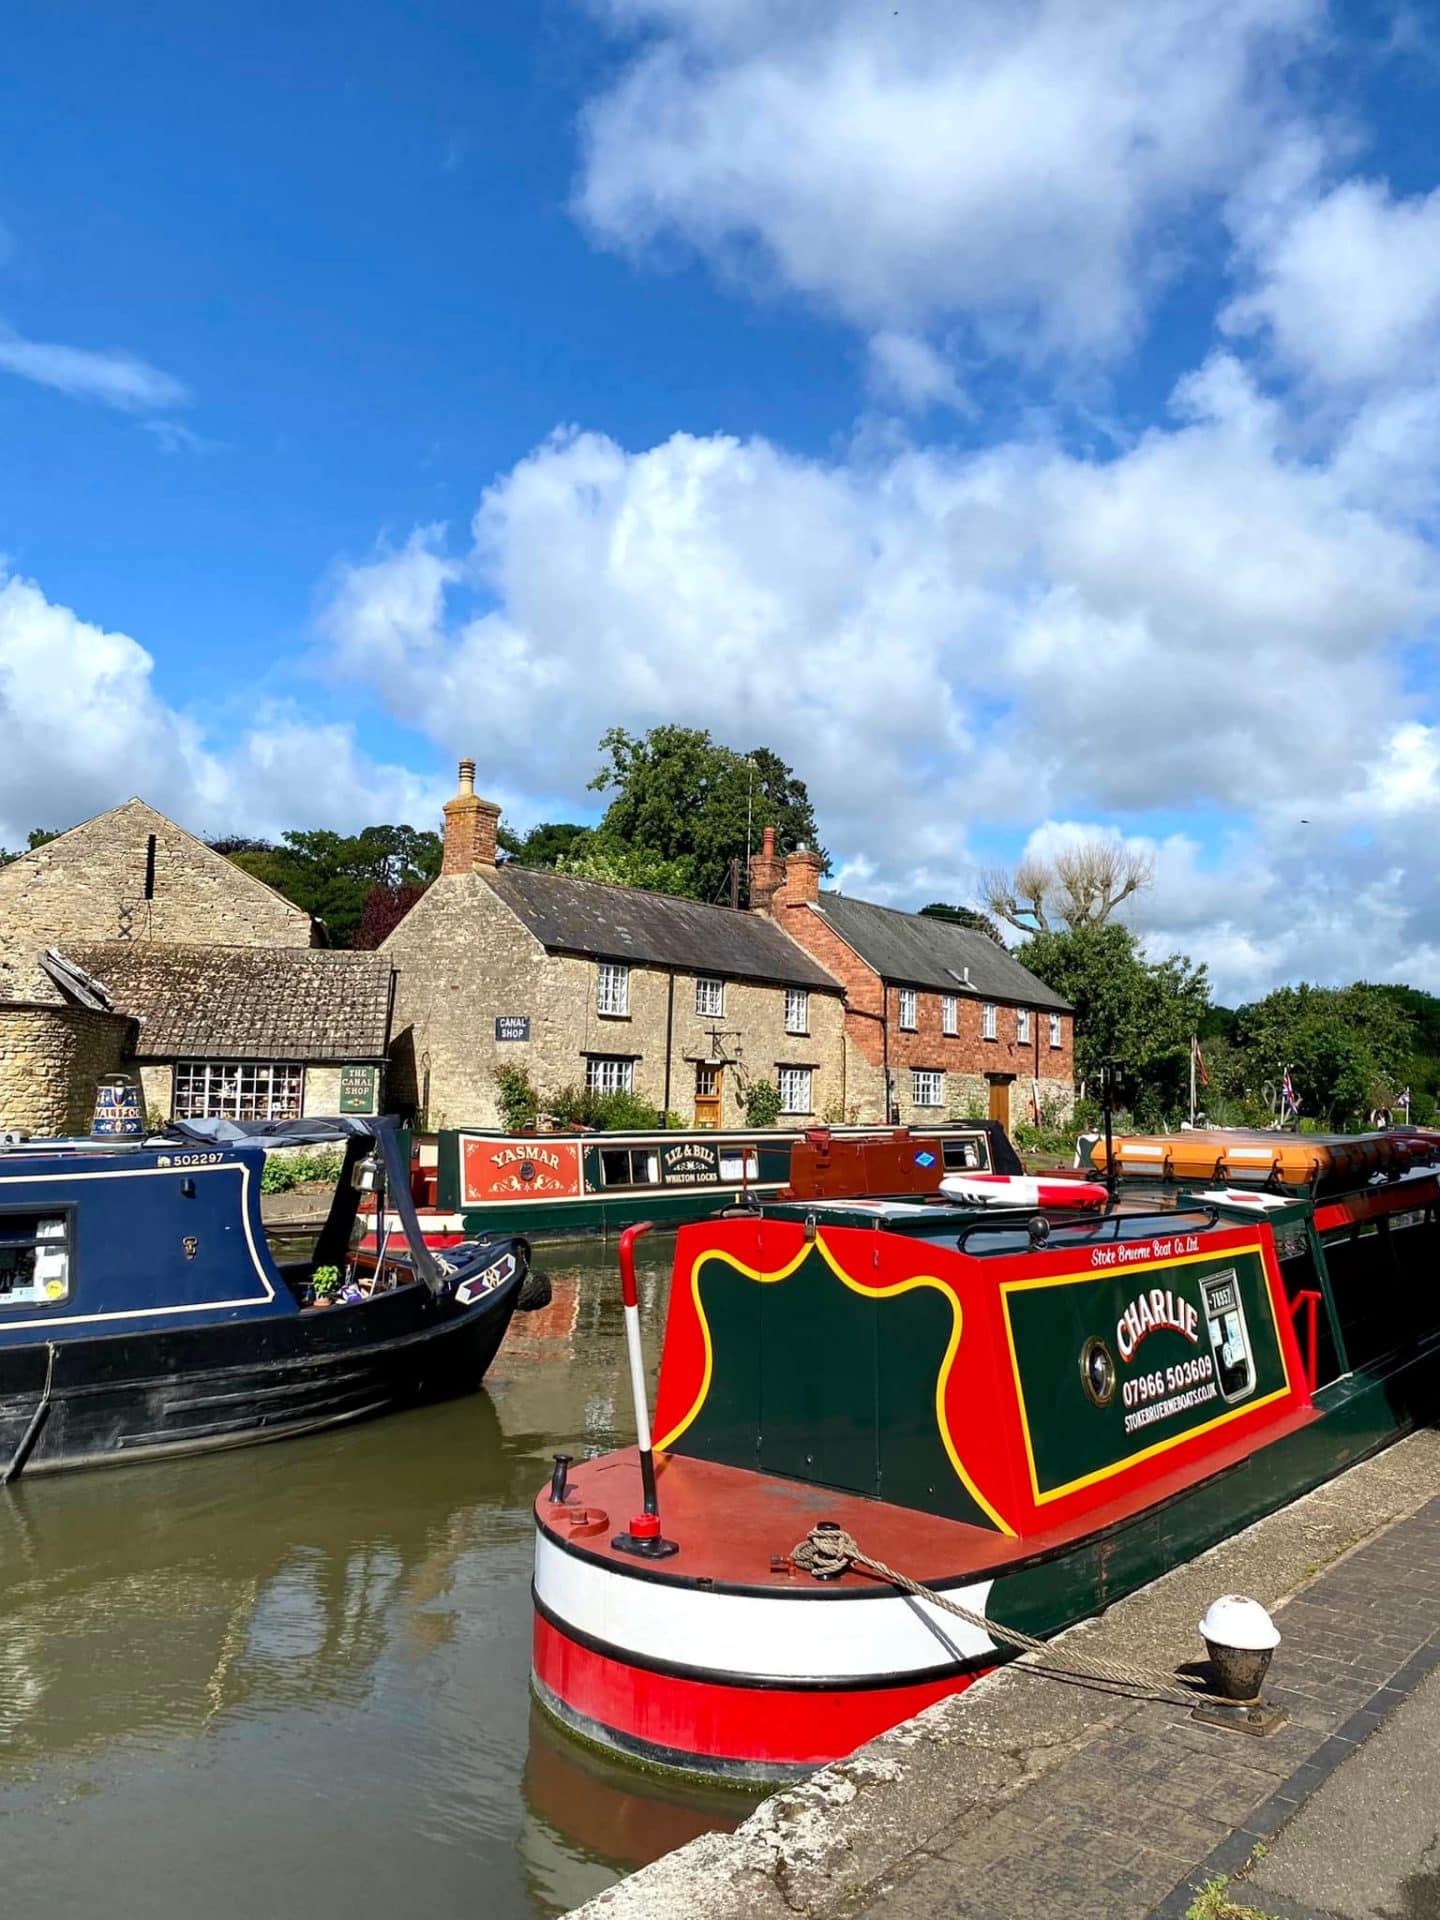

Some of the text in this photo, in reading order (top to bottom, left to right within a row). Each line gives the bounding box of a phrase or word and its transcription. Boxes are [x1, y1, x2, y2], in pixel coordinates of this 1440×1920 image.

[499, 1017, 527, 1028] CANAL
[501, 1028, 524, 1039] SHOP
[349, 1069, 367, 1077] THE
[341, 1078, 373, 1087] CANAL
[344, 1087, 370, 1096] SHOP
[174, 1152, 225, 1166] 502297
[490, 1146, 560, 1170] YASMAR
[664, 1144, 716, 1167] LIZ & BILL
[665, 1172, 718, 1184] WHILTON LOCKS
[1091, 1236, 1200, 1267] Stoke Bruerne Boat Co. Ltd.
[1117, 1288, 1199, 1361] CHARLIE
[1122, 1354, 1213, 1407] 07966 503609
[1124, 1381, 1218, 1433] STOKEBRUERNEBOATS.CO.UK
